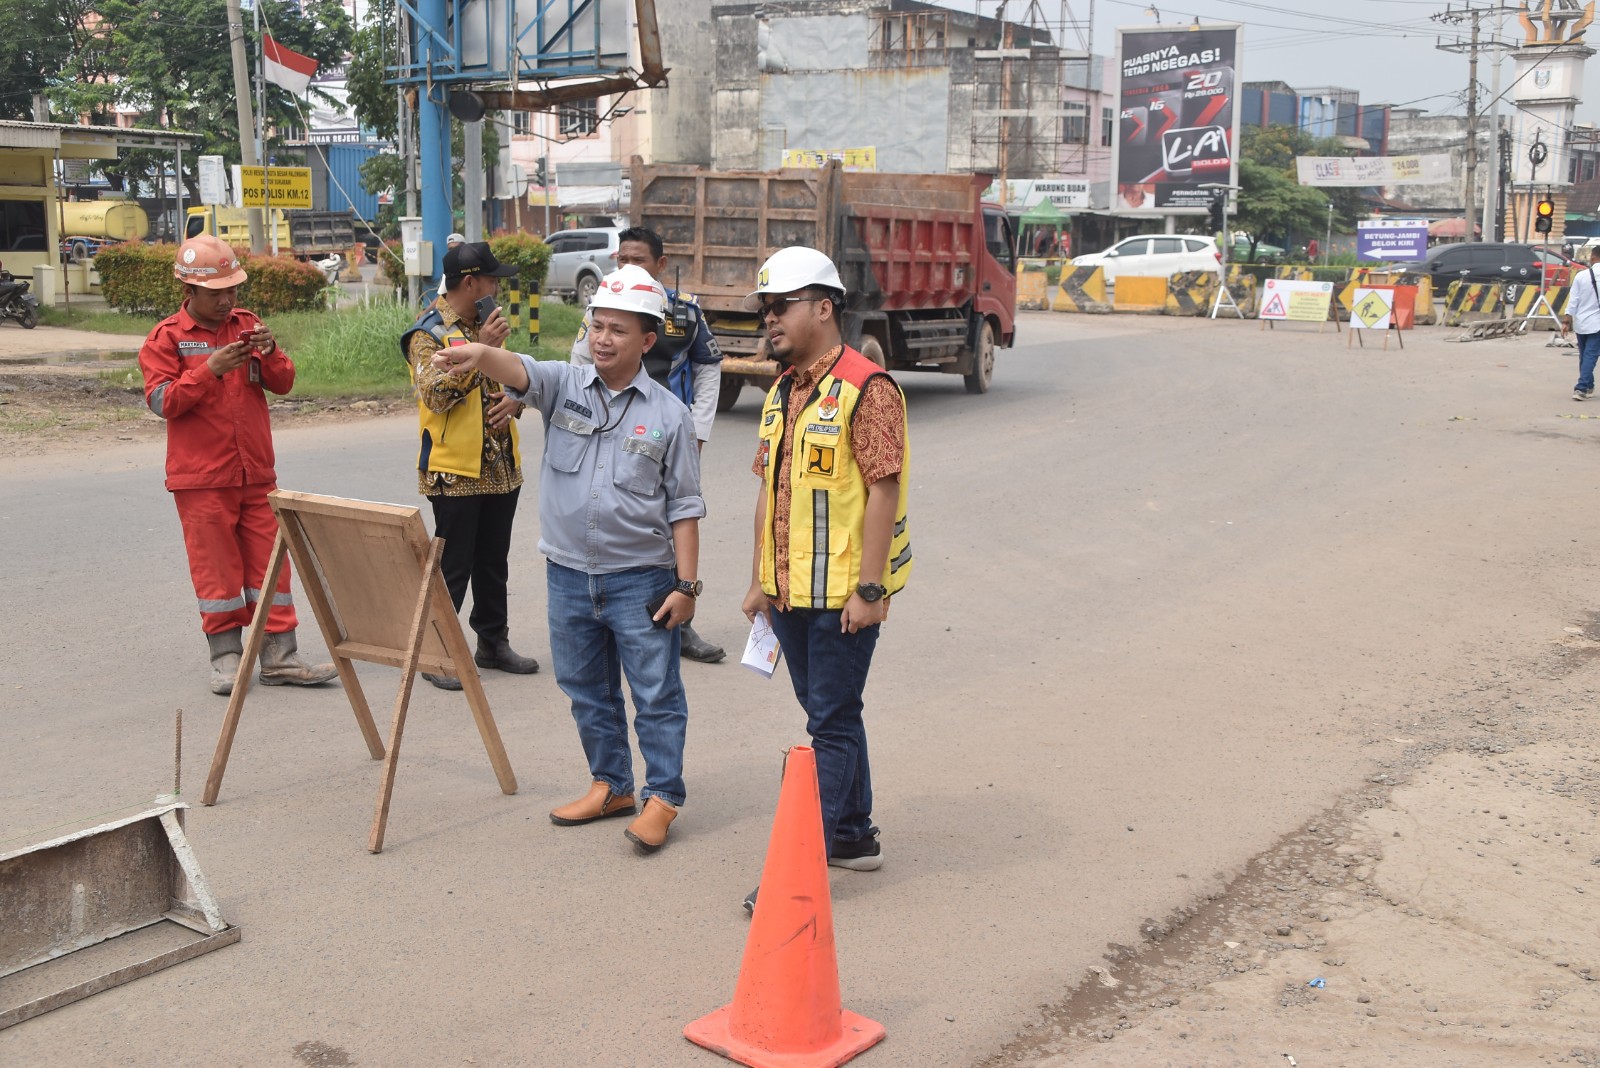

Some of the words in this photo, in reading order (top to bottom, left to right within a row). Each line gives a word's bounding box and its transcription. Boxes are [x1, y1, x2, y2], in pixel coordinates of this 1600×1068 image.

[1124, 45, 1179, 68] PUASNYA
[1124, 65, 1150, 77] TETAP
[1152, 48, 1220, 72] NGEGAS!
[1187, 71, 1222, 90] 20
[1149, 101, 1165, 111] 16
[1121, 110, 1134, 119] 12
[243, 188, 259, 199] POS
[260, 189, 285, 200] POLISI
[287, 190, 309, 200] KM.12
[1035, 184, 1065, 193] WARUNG
[1067, 184, 1086, 193] BUAH
